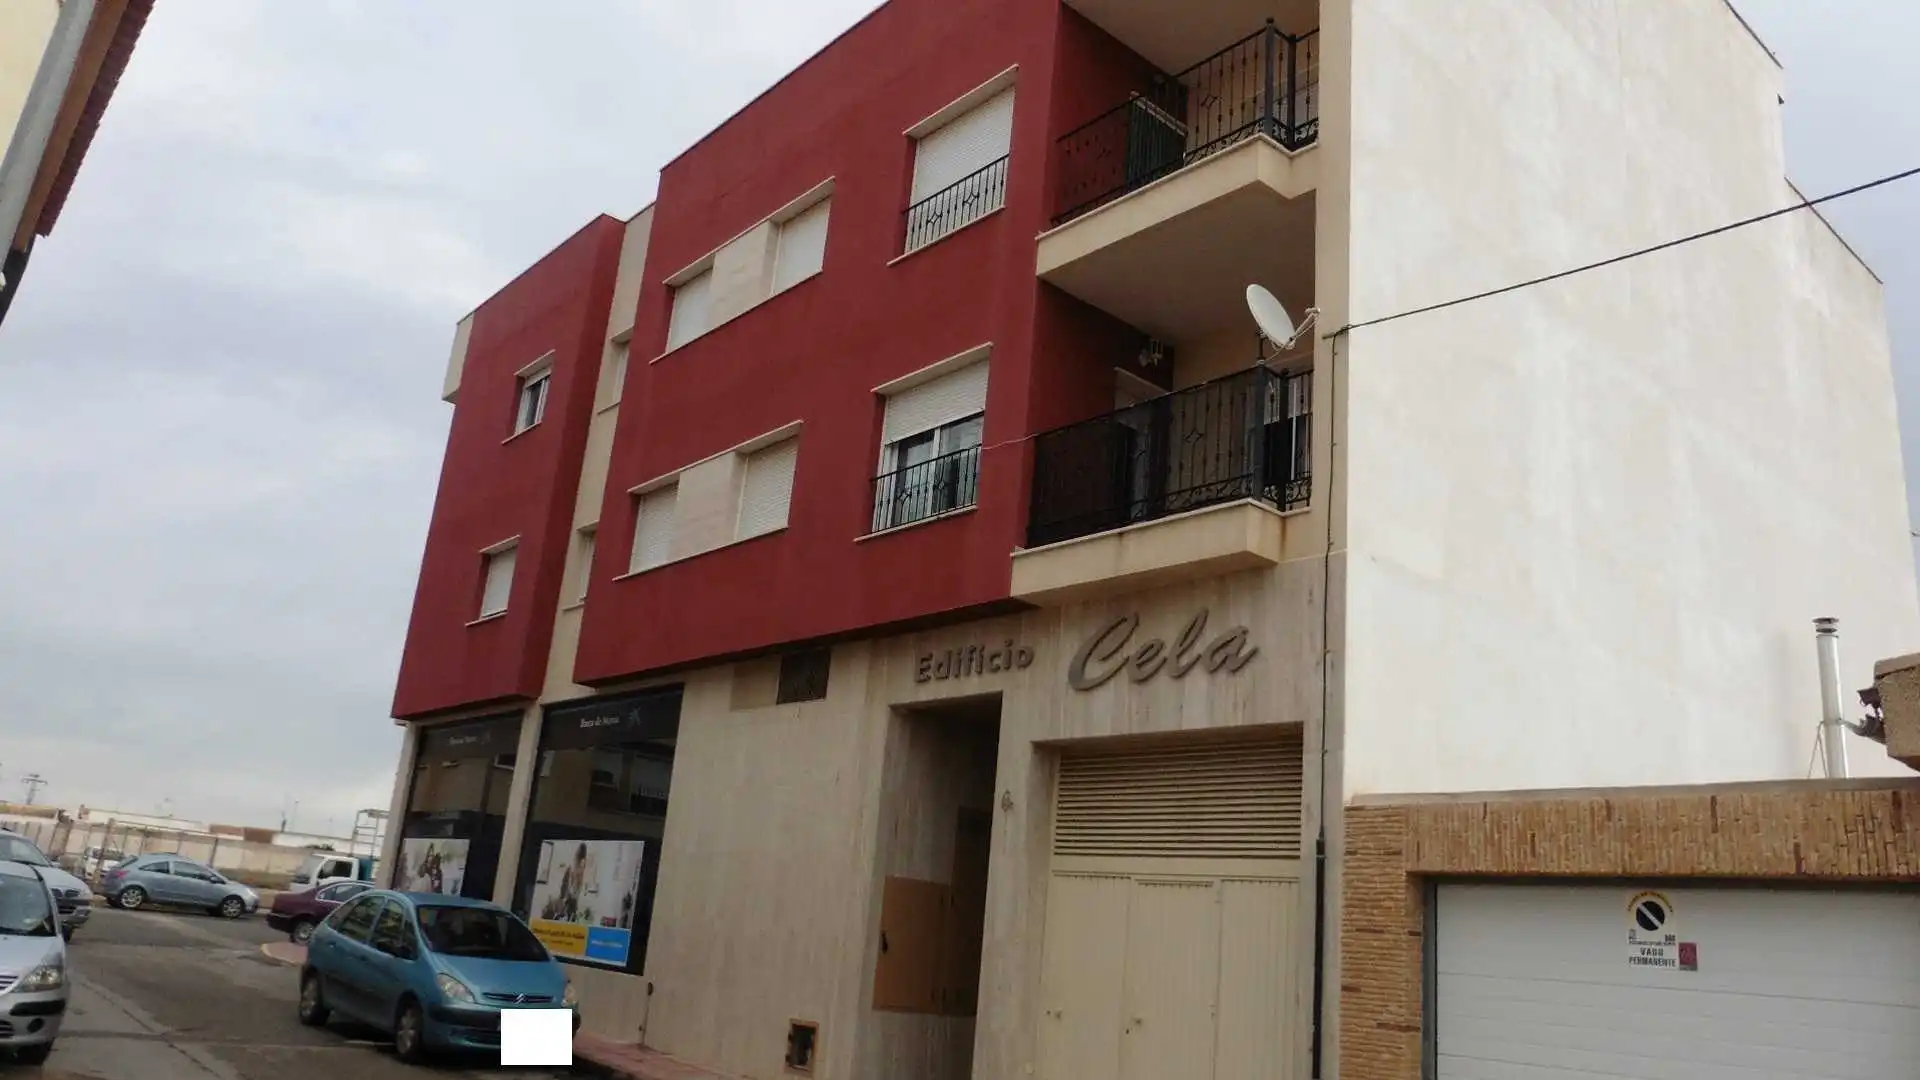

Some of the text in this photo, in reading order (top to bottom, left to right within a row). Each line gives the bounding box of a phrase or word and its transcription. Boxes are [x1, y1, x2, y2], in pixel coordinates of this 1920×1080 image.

[914, 607, 1260, 692] Edificio Cela
[1628, 956, 1677, 967] PERMANENTE
